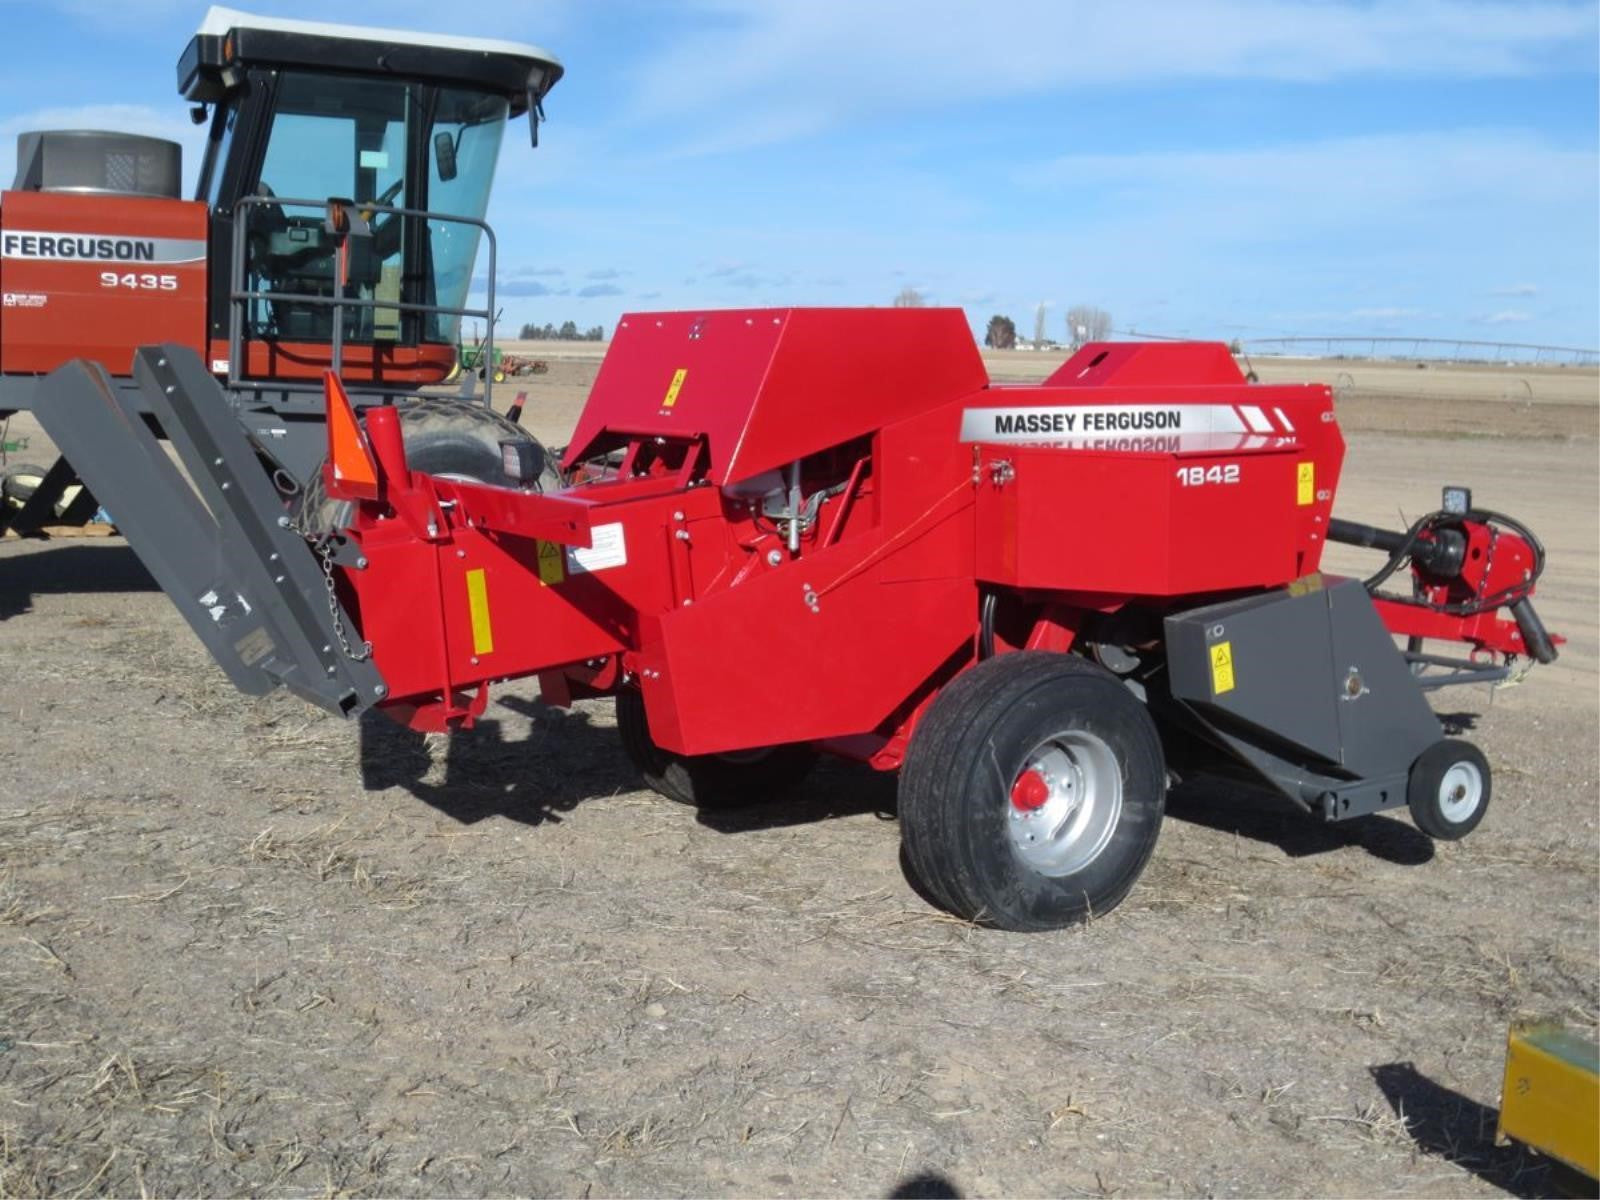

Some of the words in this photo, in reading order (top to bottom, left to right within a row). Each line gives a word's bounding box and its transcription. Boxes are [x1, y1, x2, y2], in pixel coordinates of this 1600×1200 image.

[4, 235, 155, 261] FERGUSON
[100, 272, 178, 291] 9435
[995, 413, 1077, 434] MASSEY
[1083, 411, 1181, 431] FERGUSON
[1176, 464, 1240, 487] 1842
